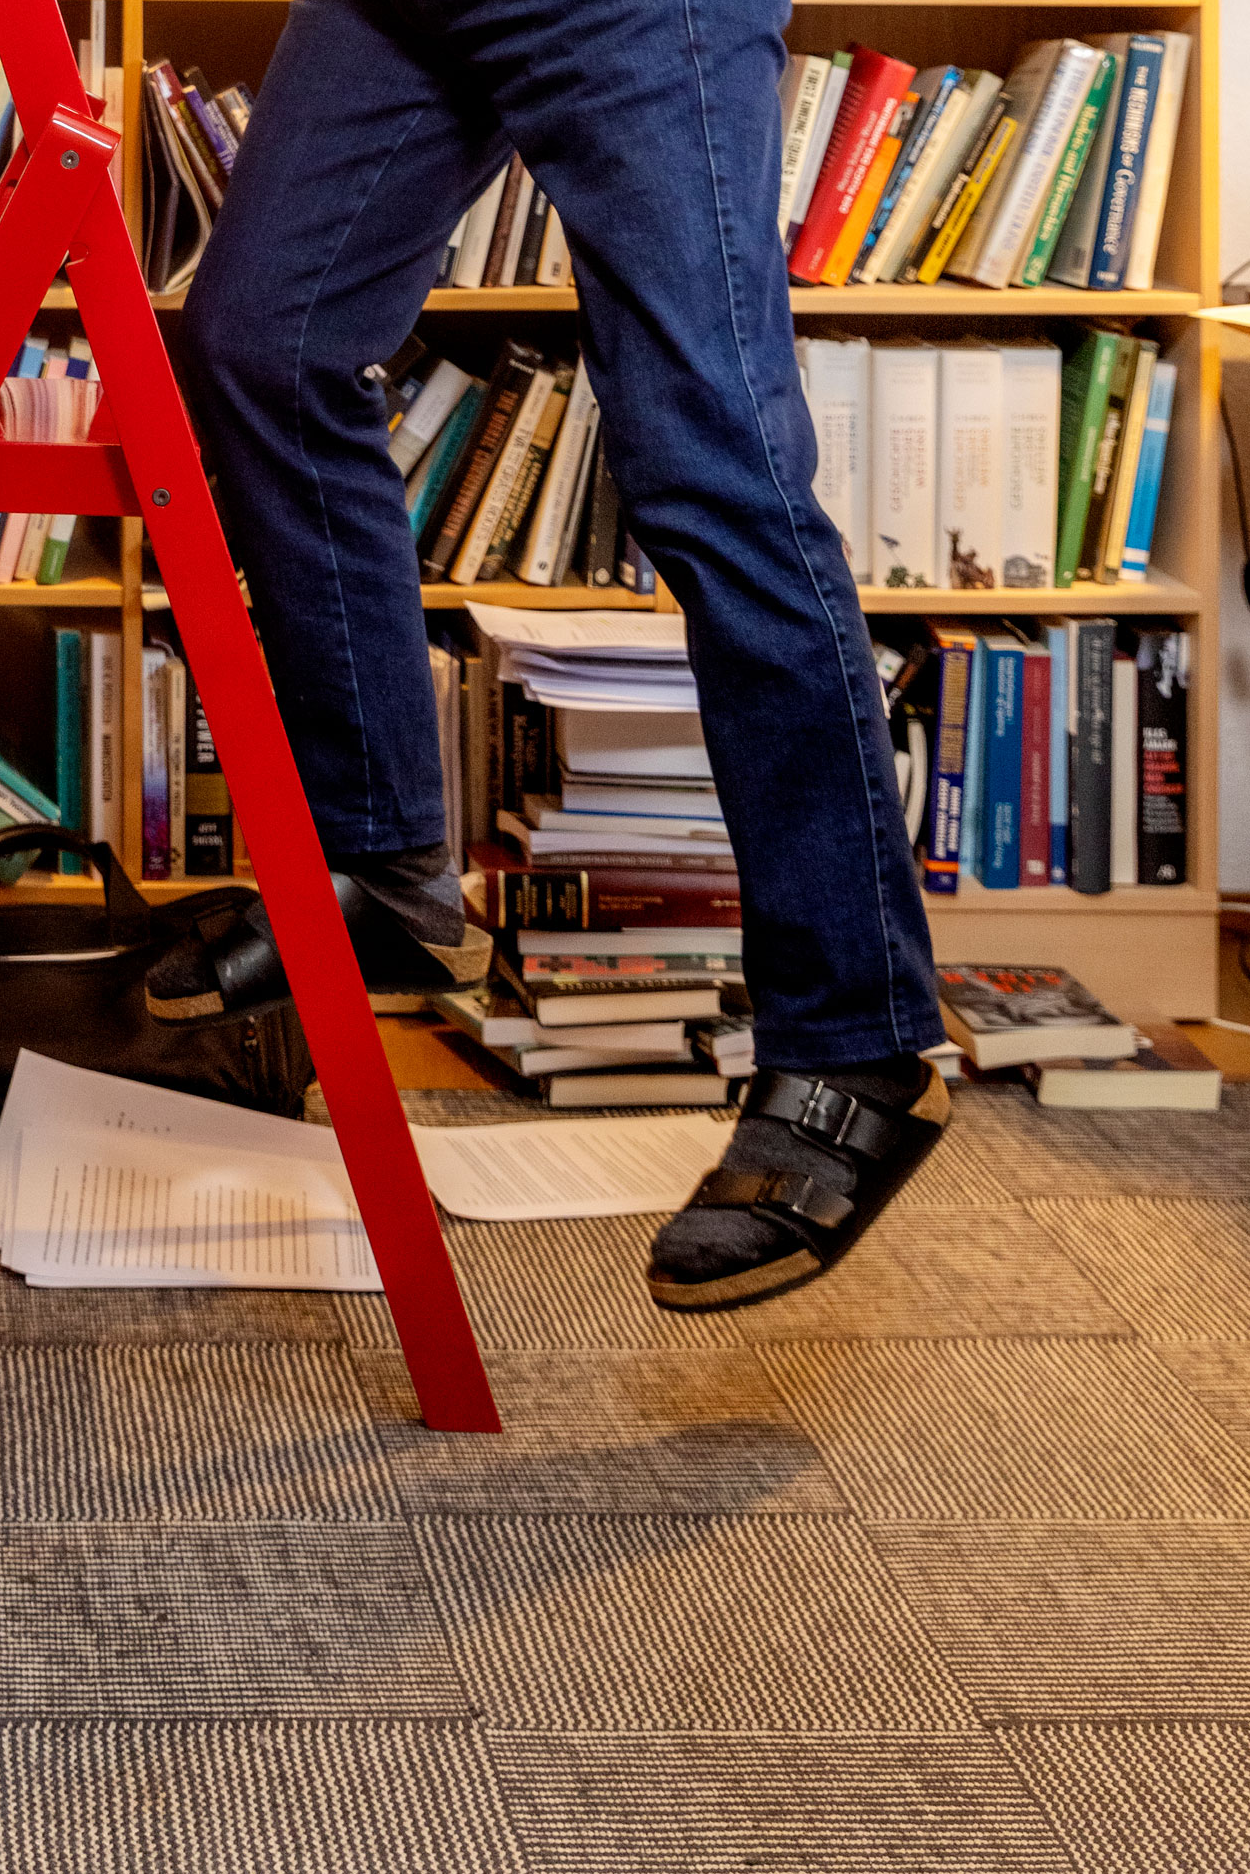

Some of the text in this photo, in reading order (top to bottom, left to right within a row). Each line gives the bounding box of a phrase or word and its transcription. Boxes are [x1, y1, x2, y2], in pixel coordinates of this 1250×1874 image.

[782, 67, 821, 176] FIRST AMONG EQUALS
[1069, 103, 1099, 152] Markets
[1061, 148, 1083, 175] and
[1101, 64, 1149, 258] THE MECHANISMS OF Governance
[1038, 173, 1074, 243] Hierarchies
